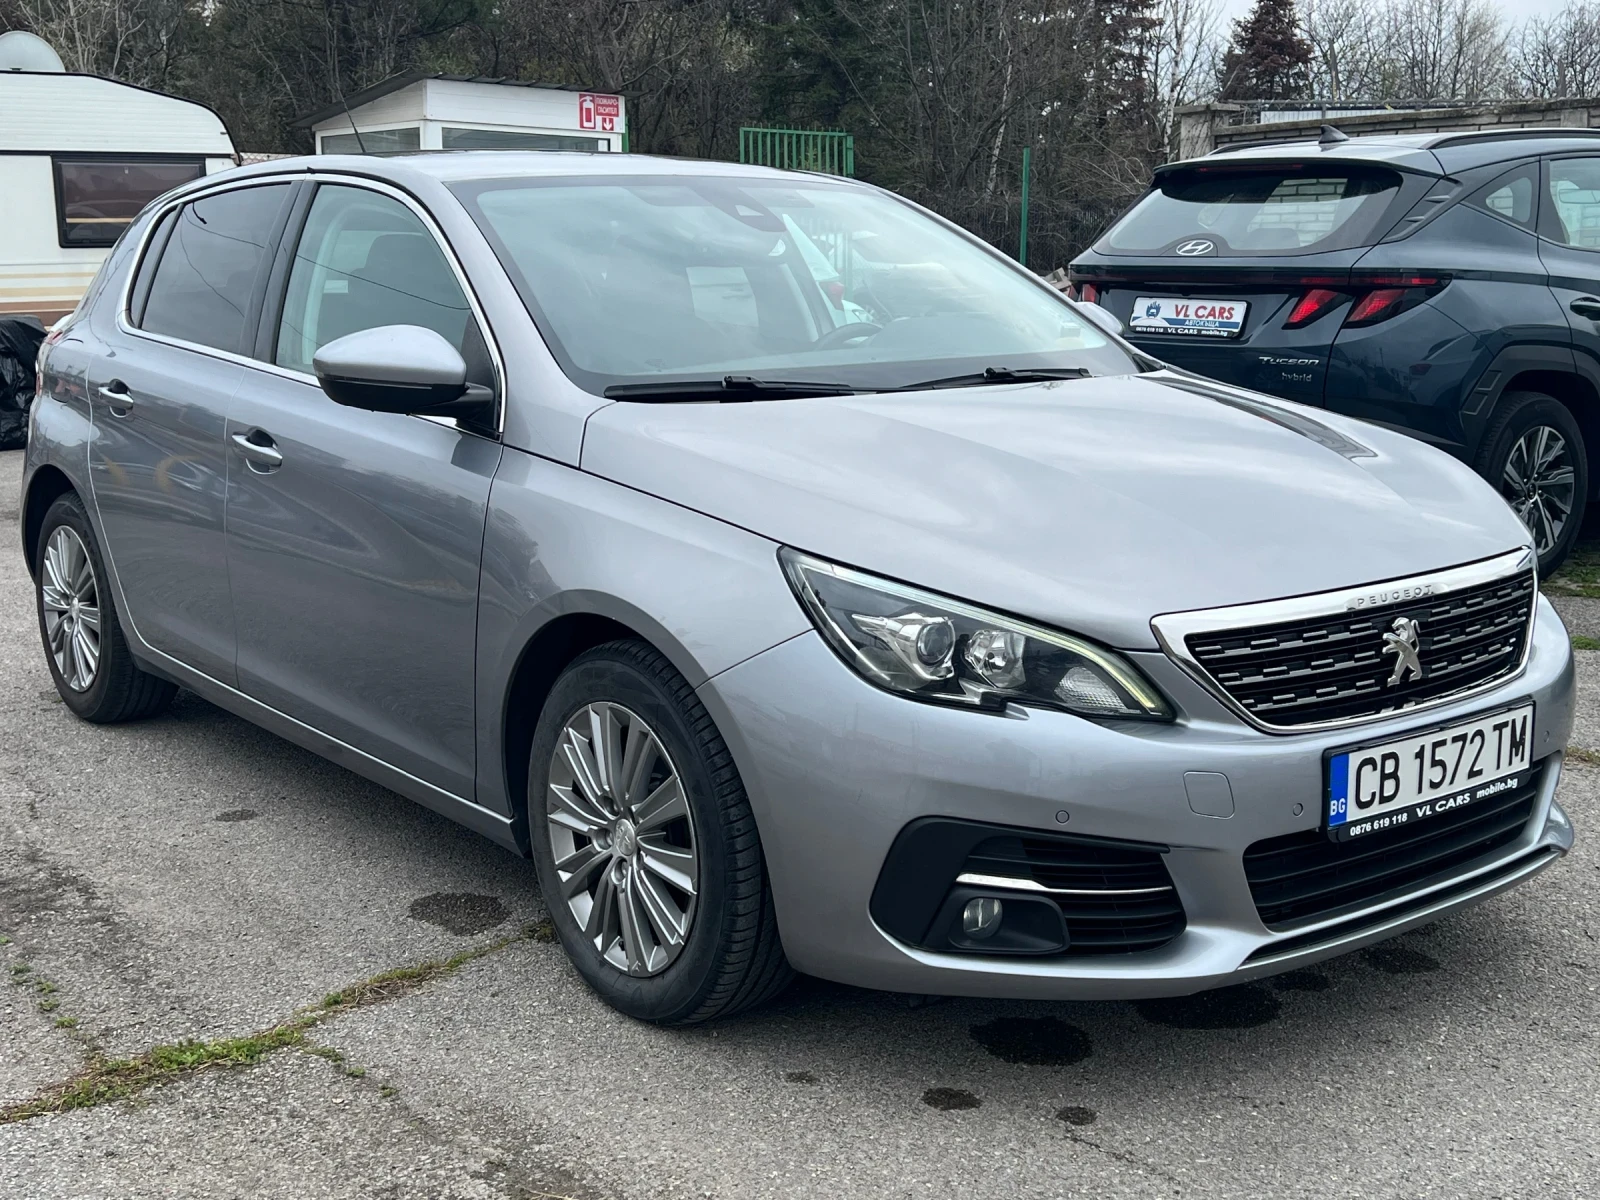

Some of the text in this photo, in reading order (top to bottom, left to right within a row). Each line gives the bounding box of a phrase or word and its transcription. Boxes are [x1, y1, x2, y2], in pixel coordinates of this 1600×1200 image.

[1174, 304, 1235, 320] VL CARS
[1184, 320, 1220, 328] АВТОКЪЩА
[1281, 372, 1312, 383] hybrid
[1357, 584, 1432, 607] PEUGEOT
[1355, 714, 1528, 810] CB 1572 TM
[1329, 798, 1346, 816] BG
[1350, 778, 1518, 836] 0876 619 118 VL CARS mobile.bg
